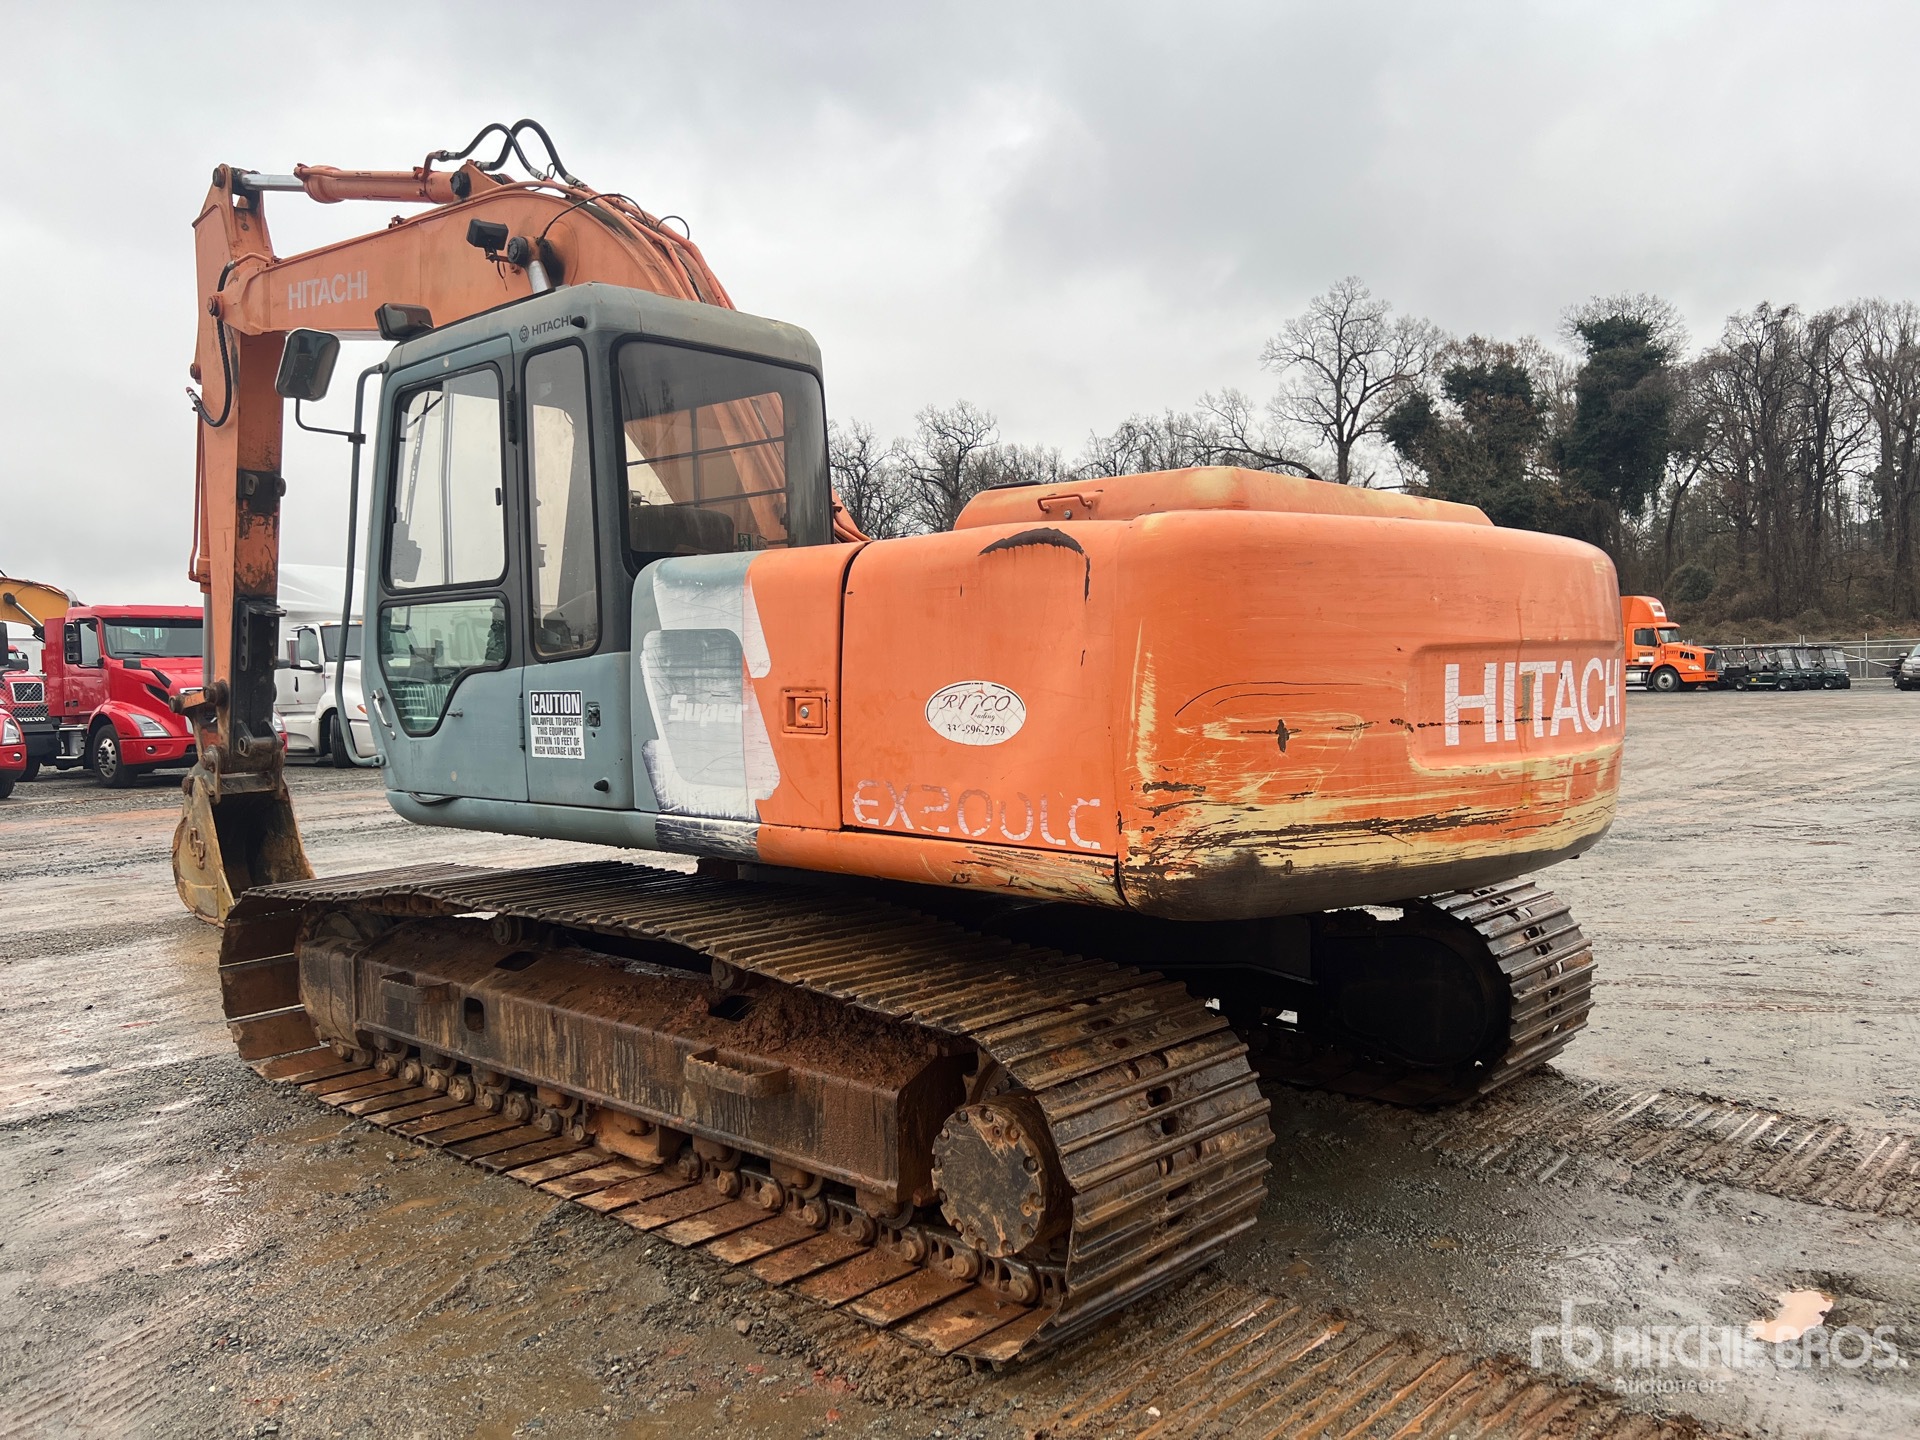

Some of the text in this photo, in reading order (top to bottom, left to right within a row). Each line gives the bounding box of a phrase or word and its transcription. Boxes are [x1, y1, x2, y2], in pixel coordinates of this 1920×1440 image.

[288, 270, 368, 310] HITACHI
[531, 315, 572, 336] HITACHI
[532, 694, 580, 714] CAUTION
[667, 694, 749, 727] Super
[1444, 657, 1620, 746] HITACHI
[531, 717, 582, 726] UNLAWFUL TO OPERATE
[537, 727, 576, 736] THIS EQUIPMENT
[534, 746, 582, 756] HIGH VOLTAGE LINES
[535, 736, 580, 746] WITHIN 10 FEET OF
[852, 779, 1102, 850] EX200LC
